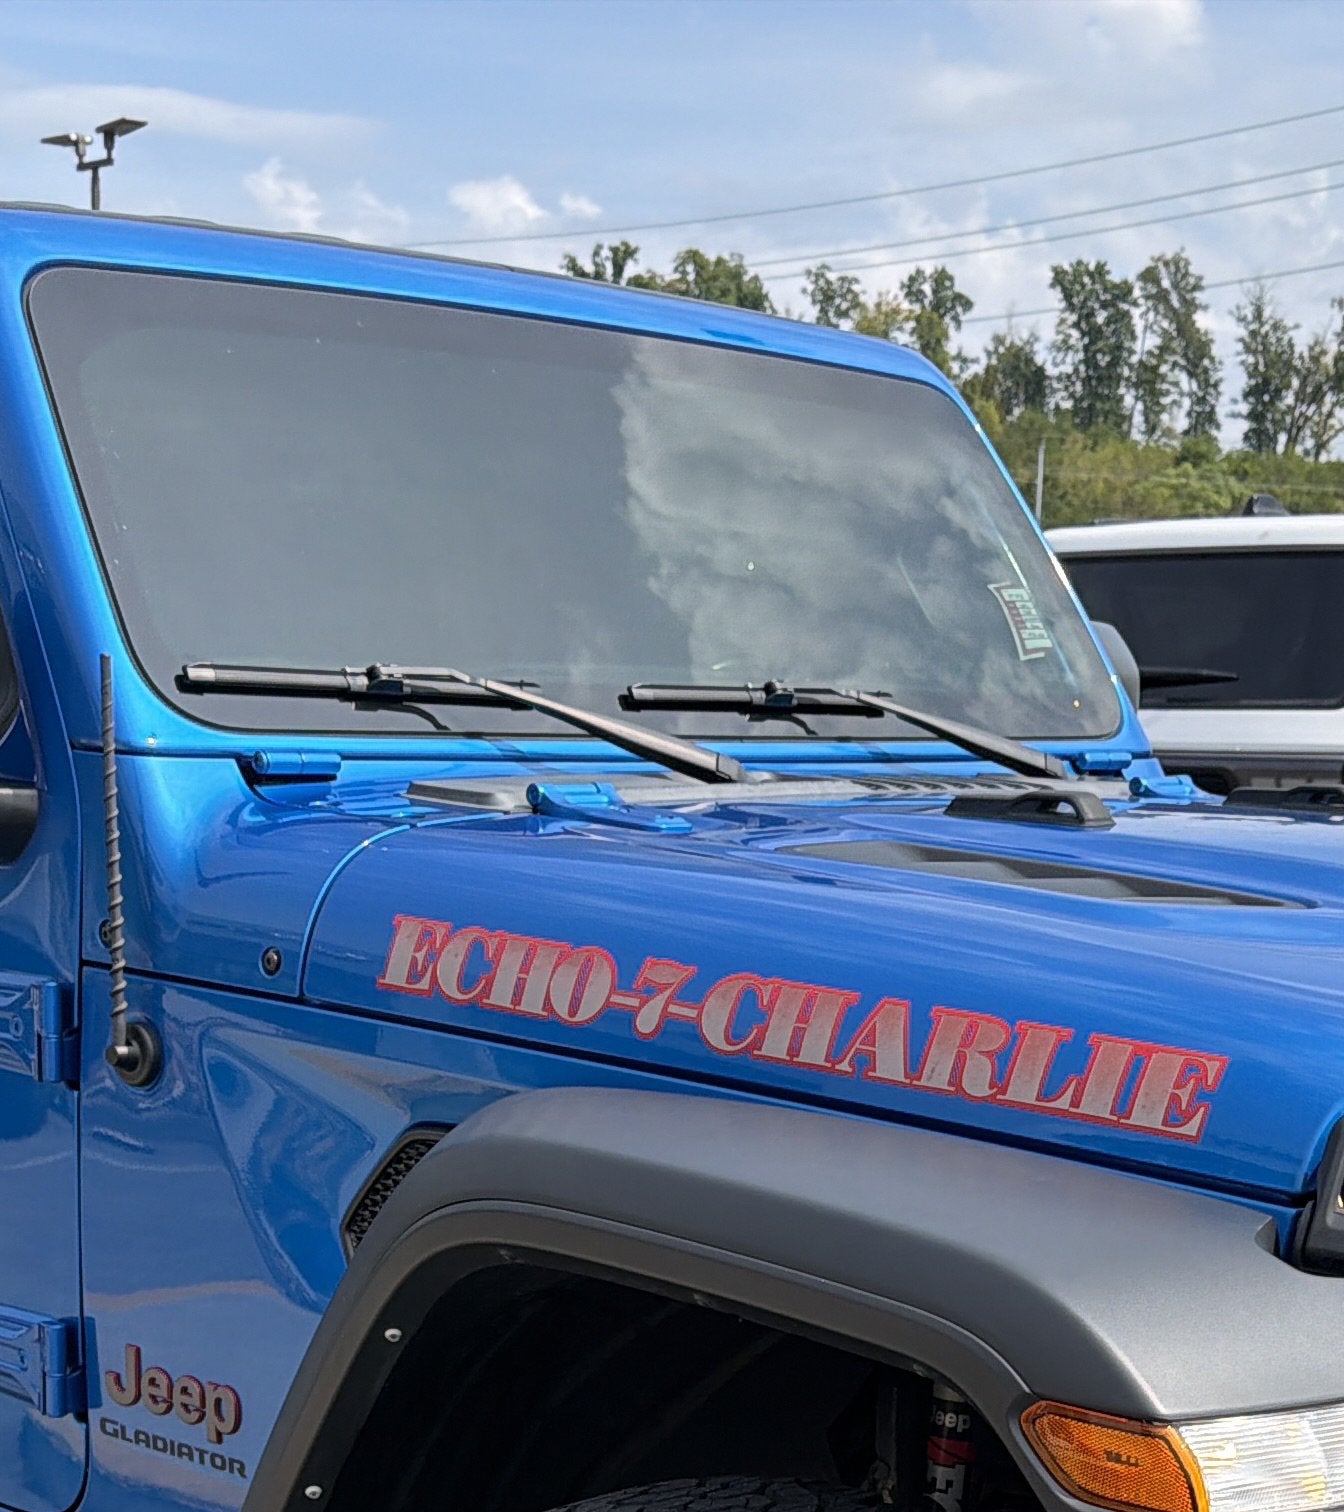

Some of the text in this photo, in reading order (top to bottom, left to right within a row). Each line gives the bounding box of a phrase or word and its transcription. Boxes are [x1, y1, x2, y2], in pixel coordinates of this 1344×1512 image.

[375, 912, 1230, 1143] ECHO-7-CHARLIE
[105, 1343, 243, 1445] Jeep
[99, 1416, 248, 1479] GLADIATOR
